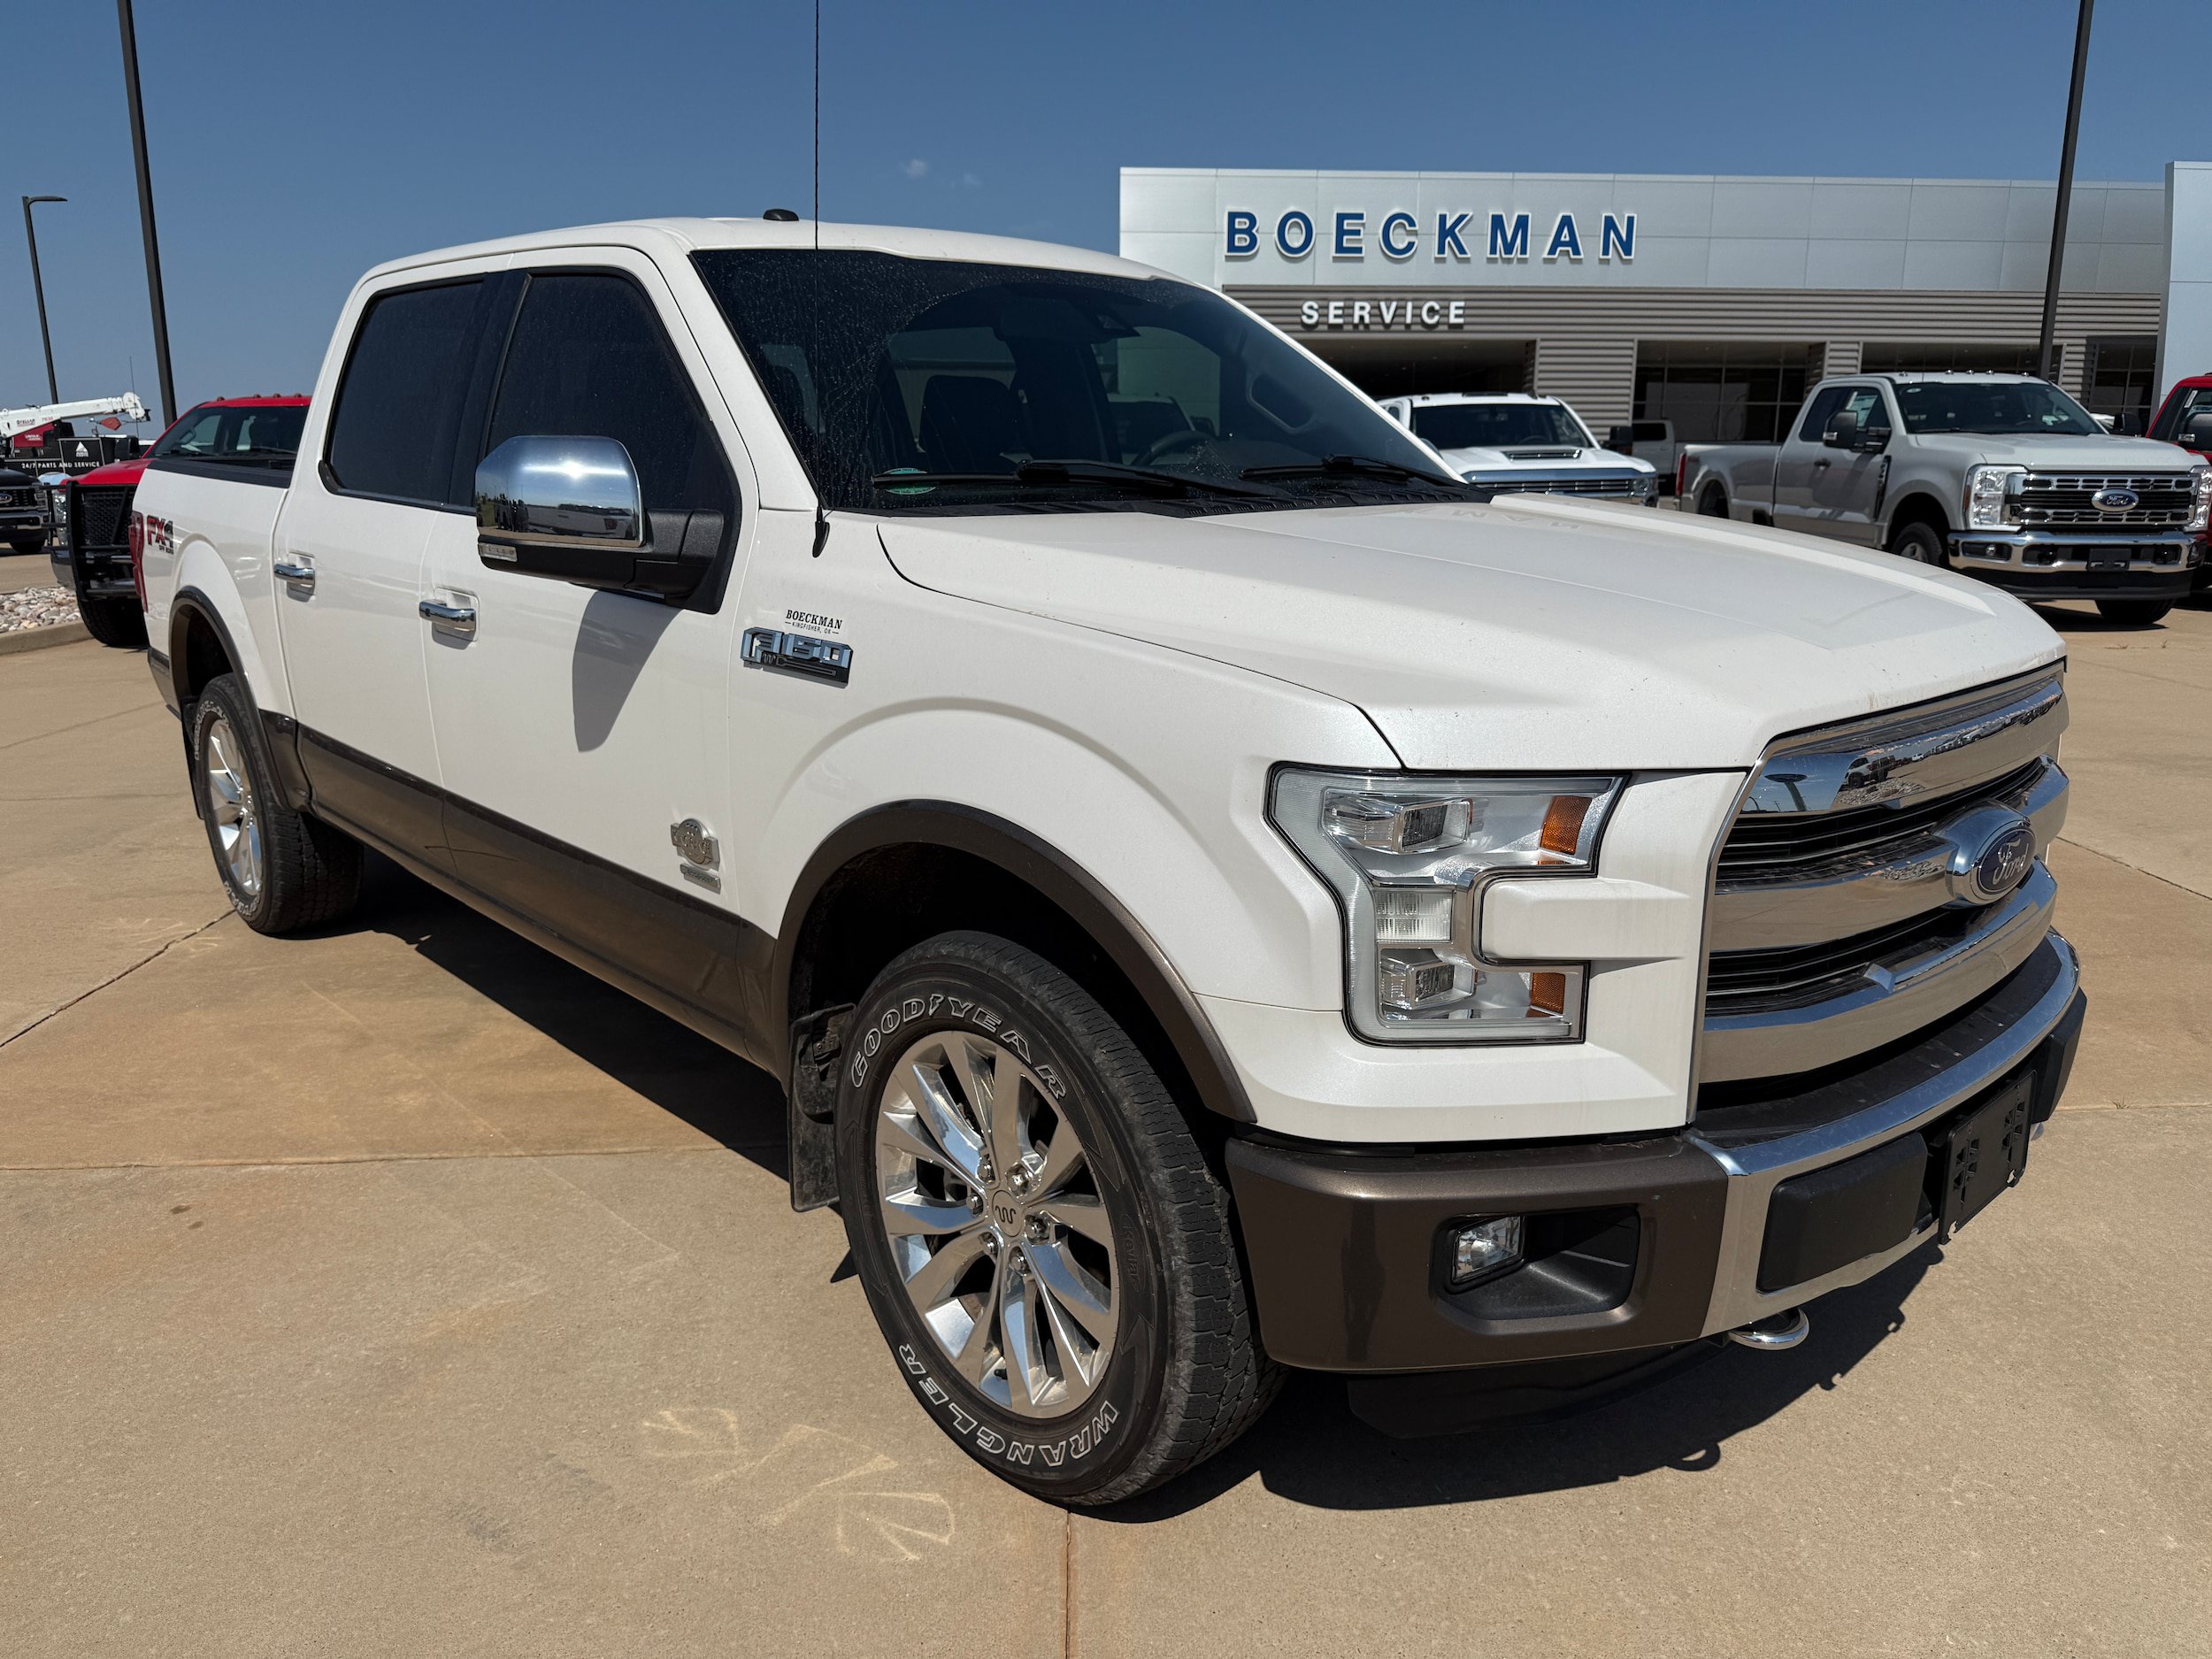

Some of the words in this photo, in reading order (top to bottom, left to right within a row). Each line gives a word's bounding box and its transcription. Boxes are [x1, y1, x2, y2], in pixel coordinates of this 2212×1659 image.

[1225, 209, 1638, 261] BOECKMAN
[1302, 300, 1466, 326] SERVICE
[2107, 495, 2129, 505] Ford
[147, 515, 173, 548] FX4
[786, 610, 842, 629] BOECKMAN
[1993, 838, 2030, 885] Ford
[851, 994, 1066, 1100] GOODYEAR
[899, 1344, 1119, 1467] WRANGLER
